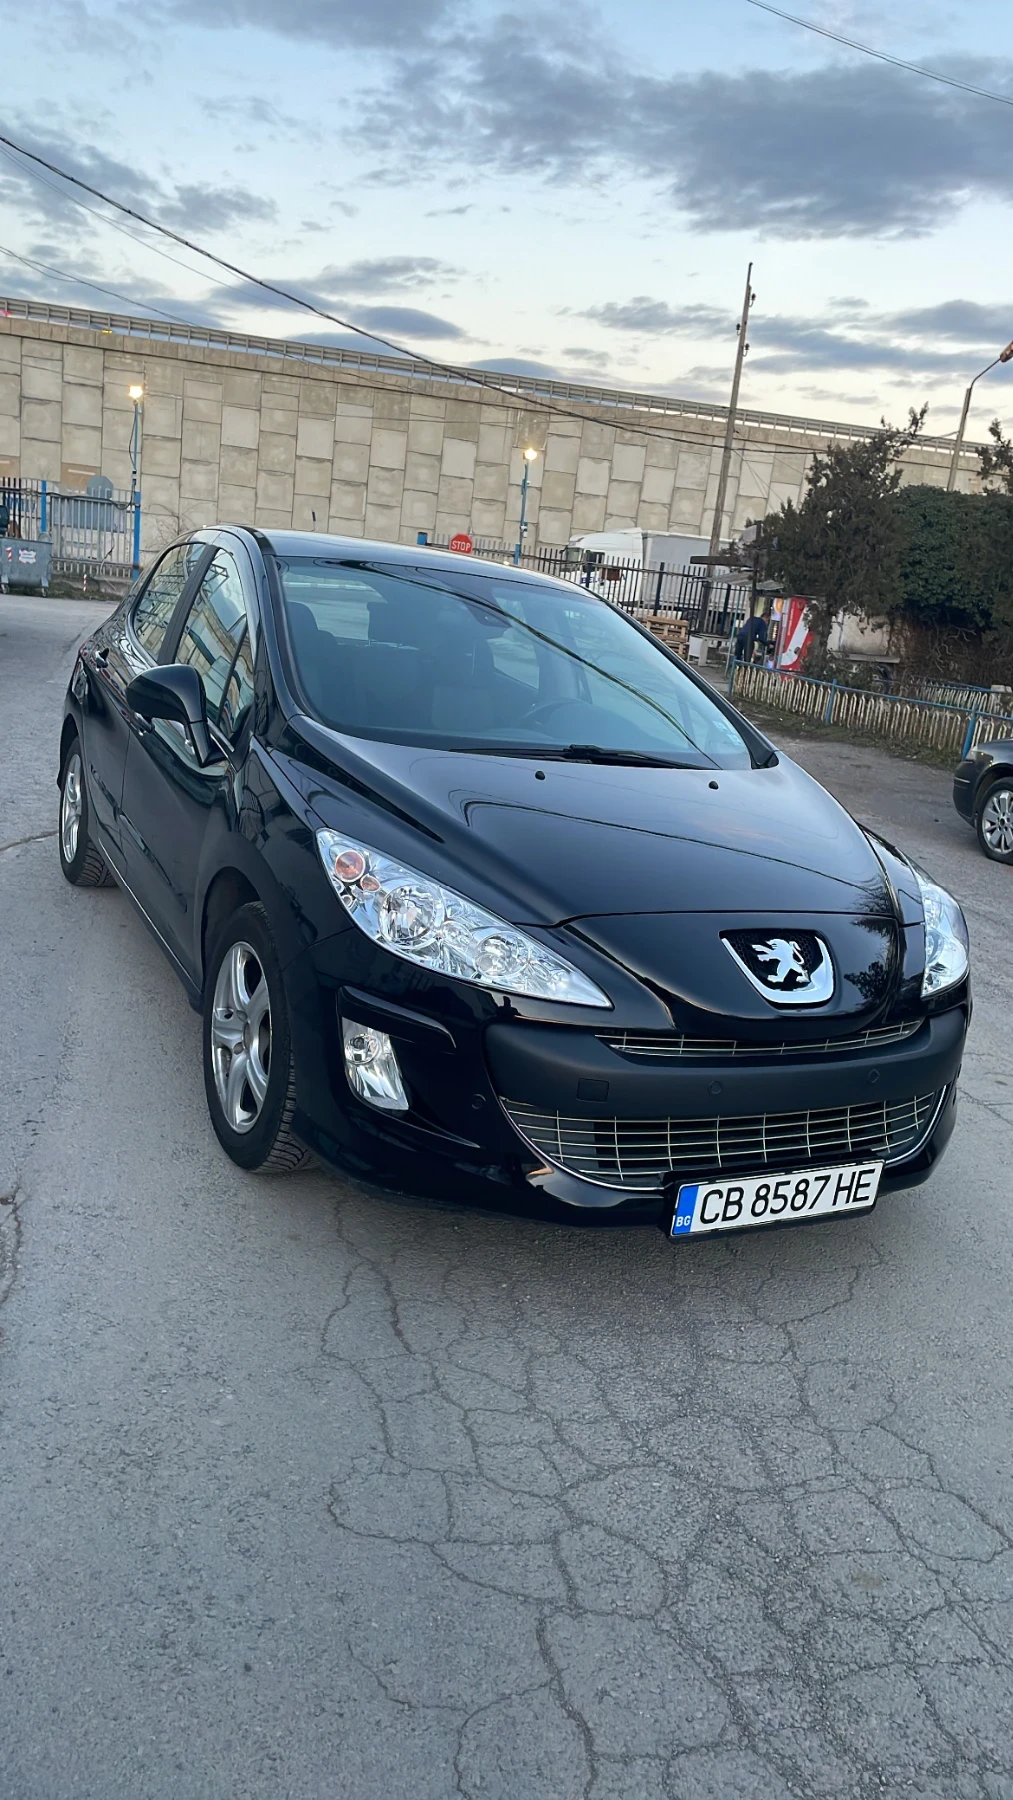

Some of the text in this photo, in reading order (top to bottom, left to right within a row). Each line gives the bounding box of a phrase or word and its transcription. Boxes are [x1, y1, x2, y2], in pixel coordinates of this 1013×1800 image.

[451, 540, 471, 552] STOP
[699, 1168, 876, 1225] CB 8587 HE
[676, 1215, 691, 1227] BG
